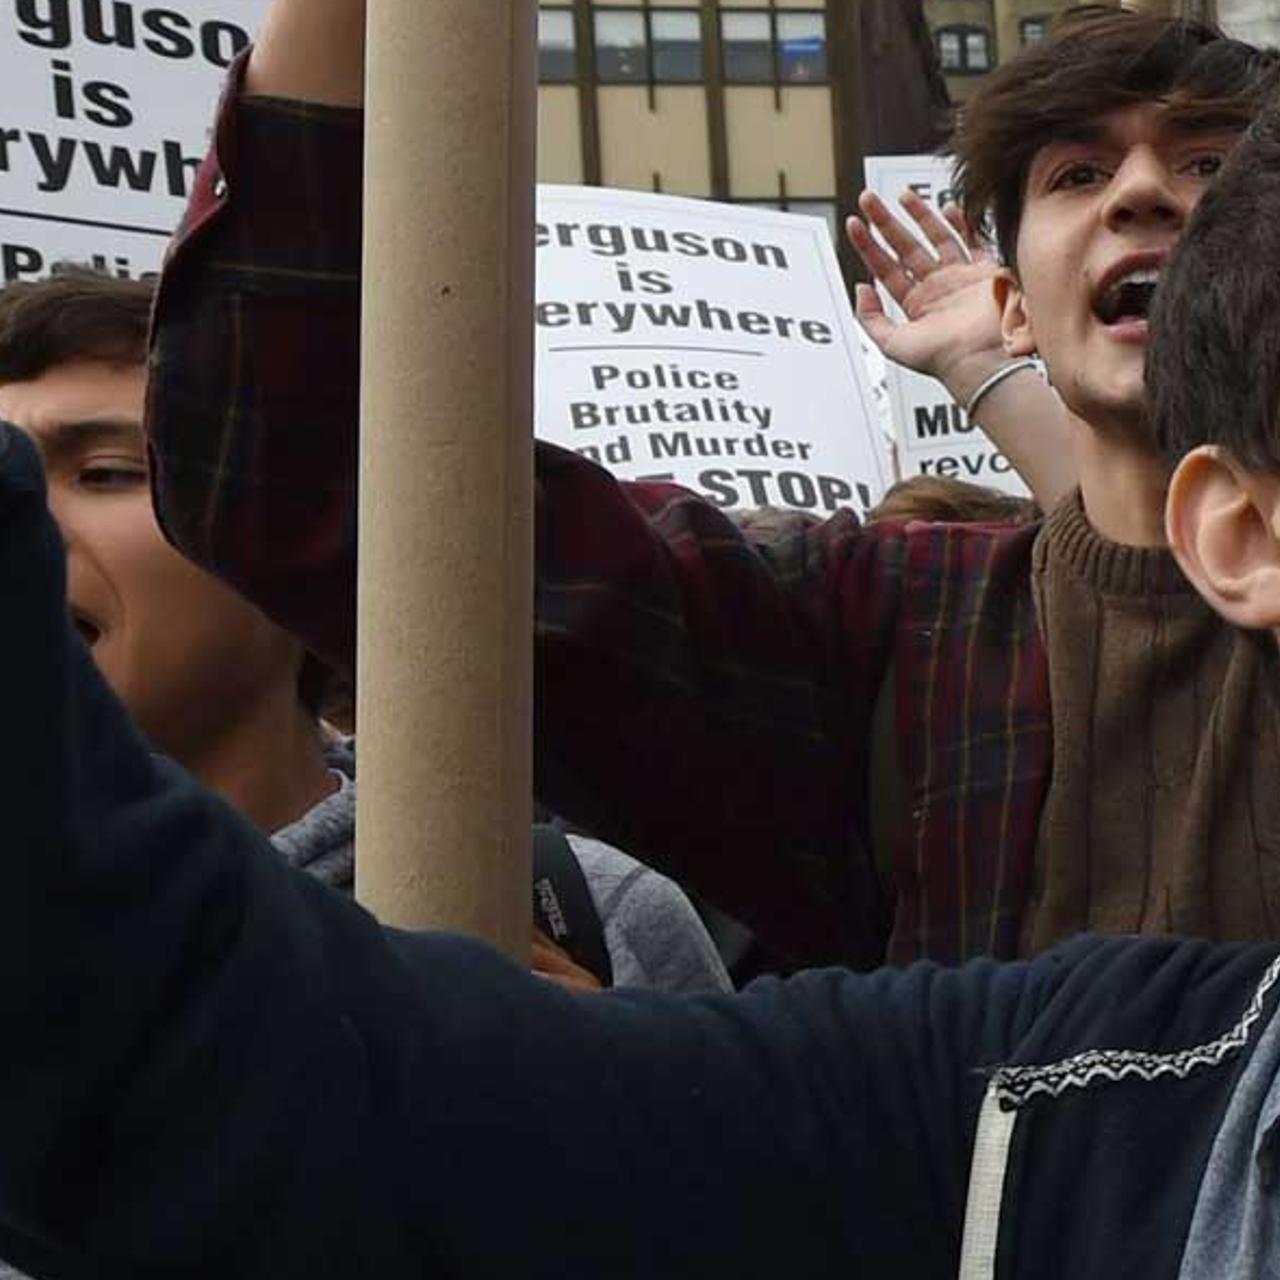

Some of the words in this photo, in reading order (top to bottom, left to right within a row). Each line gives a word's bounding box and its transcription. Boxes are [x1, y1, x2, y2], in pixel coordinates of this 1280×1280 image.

[51, 59, 134, 128] is
[616, 261, 673, 295] is
[536, 298, 833, 346] erywhere
[591, 363, 740, 392] Police
[569, 397, 773, 430] Brutality
[648, 431, 813, 461] Murder
